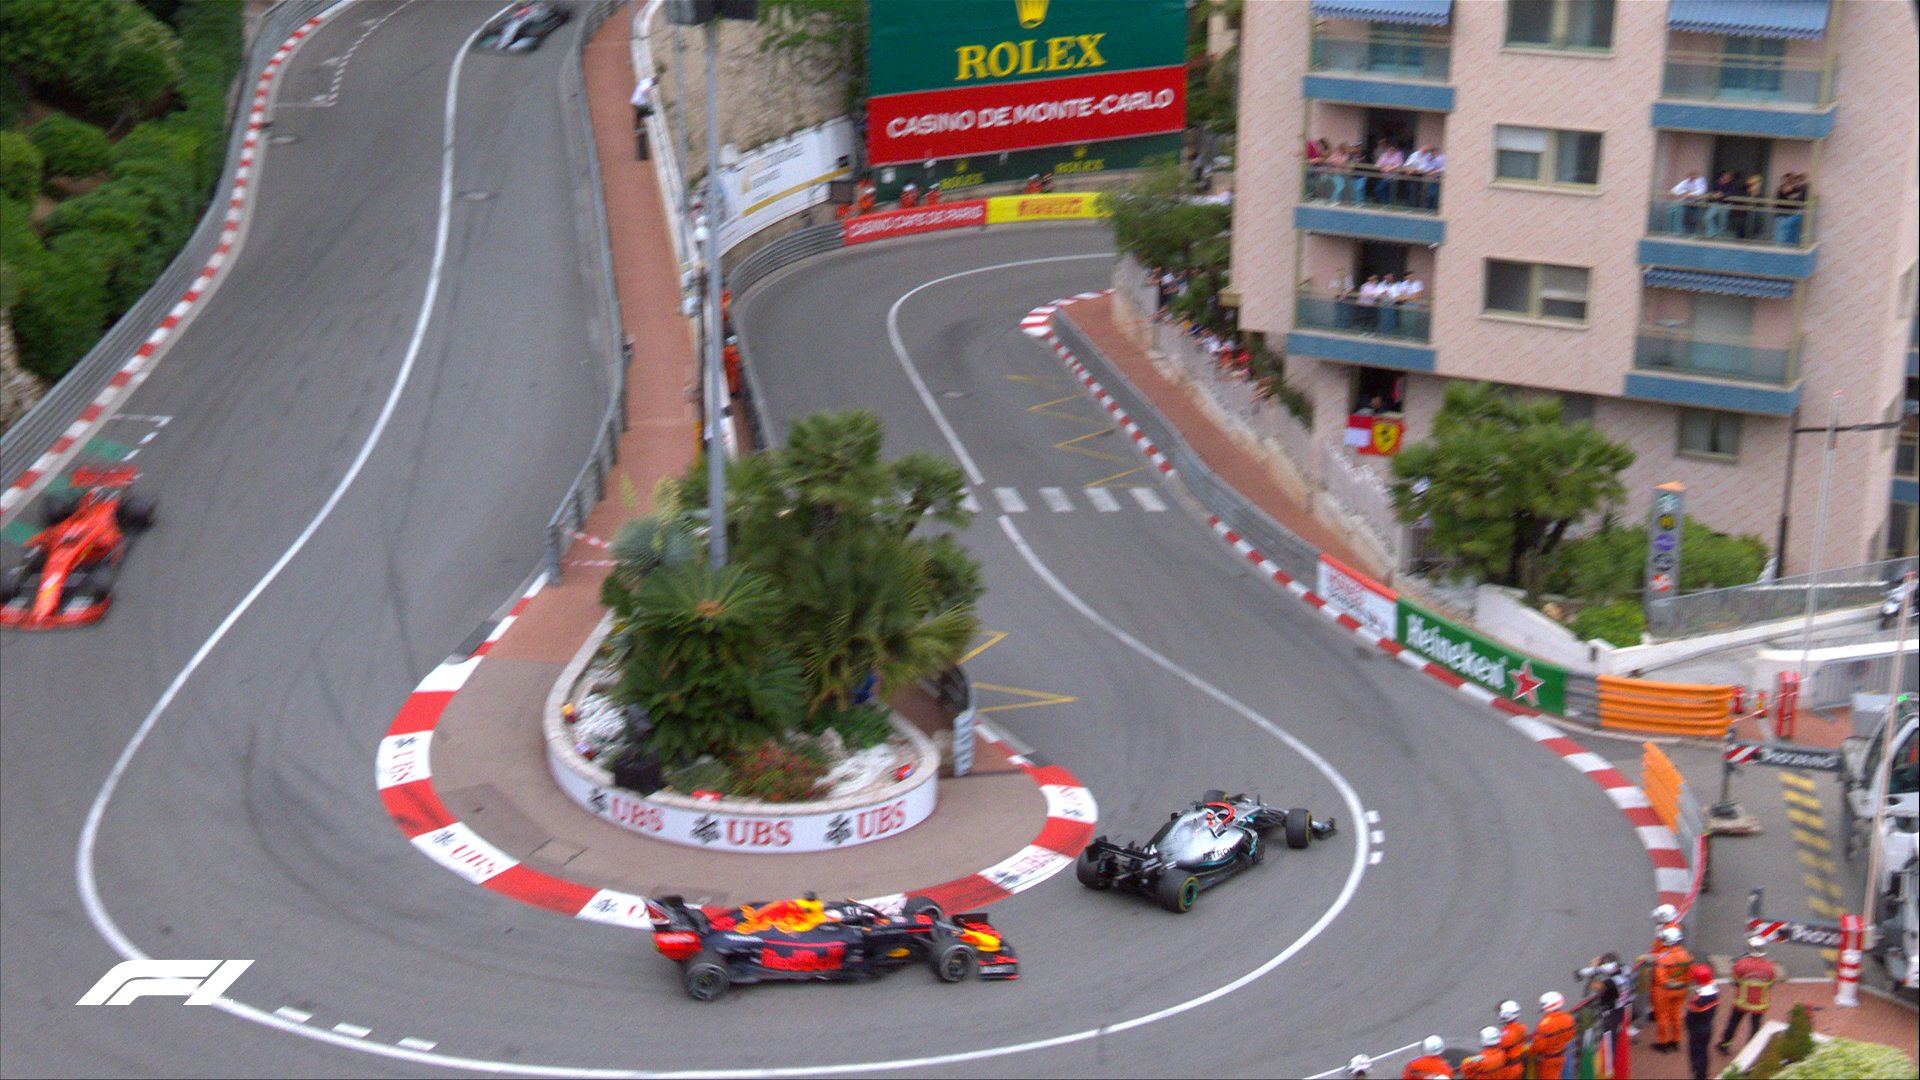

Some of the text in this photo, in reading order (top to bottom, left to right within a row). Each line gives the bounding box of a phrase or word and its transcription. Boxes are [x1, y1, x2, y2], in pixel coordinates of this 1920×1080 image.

[955, 33, 1107, 81] ROLEX
[886, 87, 1174, 138] CASINO DE MONTE-CARLO
[1406, 614, 1508, 690] Heineken
[610, 797, 664, 833] UBS
[725, 818, 794, 848] UBS
[856, 800, 907, 839] UBS
[448, 844, 501, 876] UBS
[1202, 844, 1242, 860] PETRON
